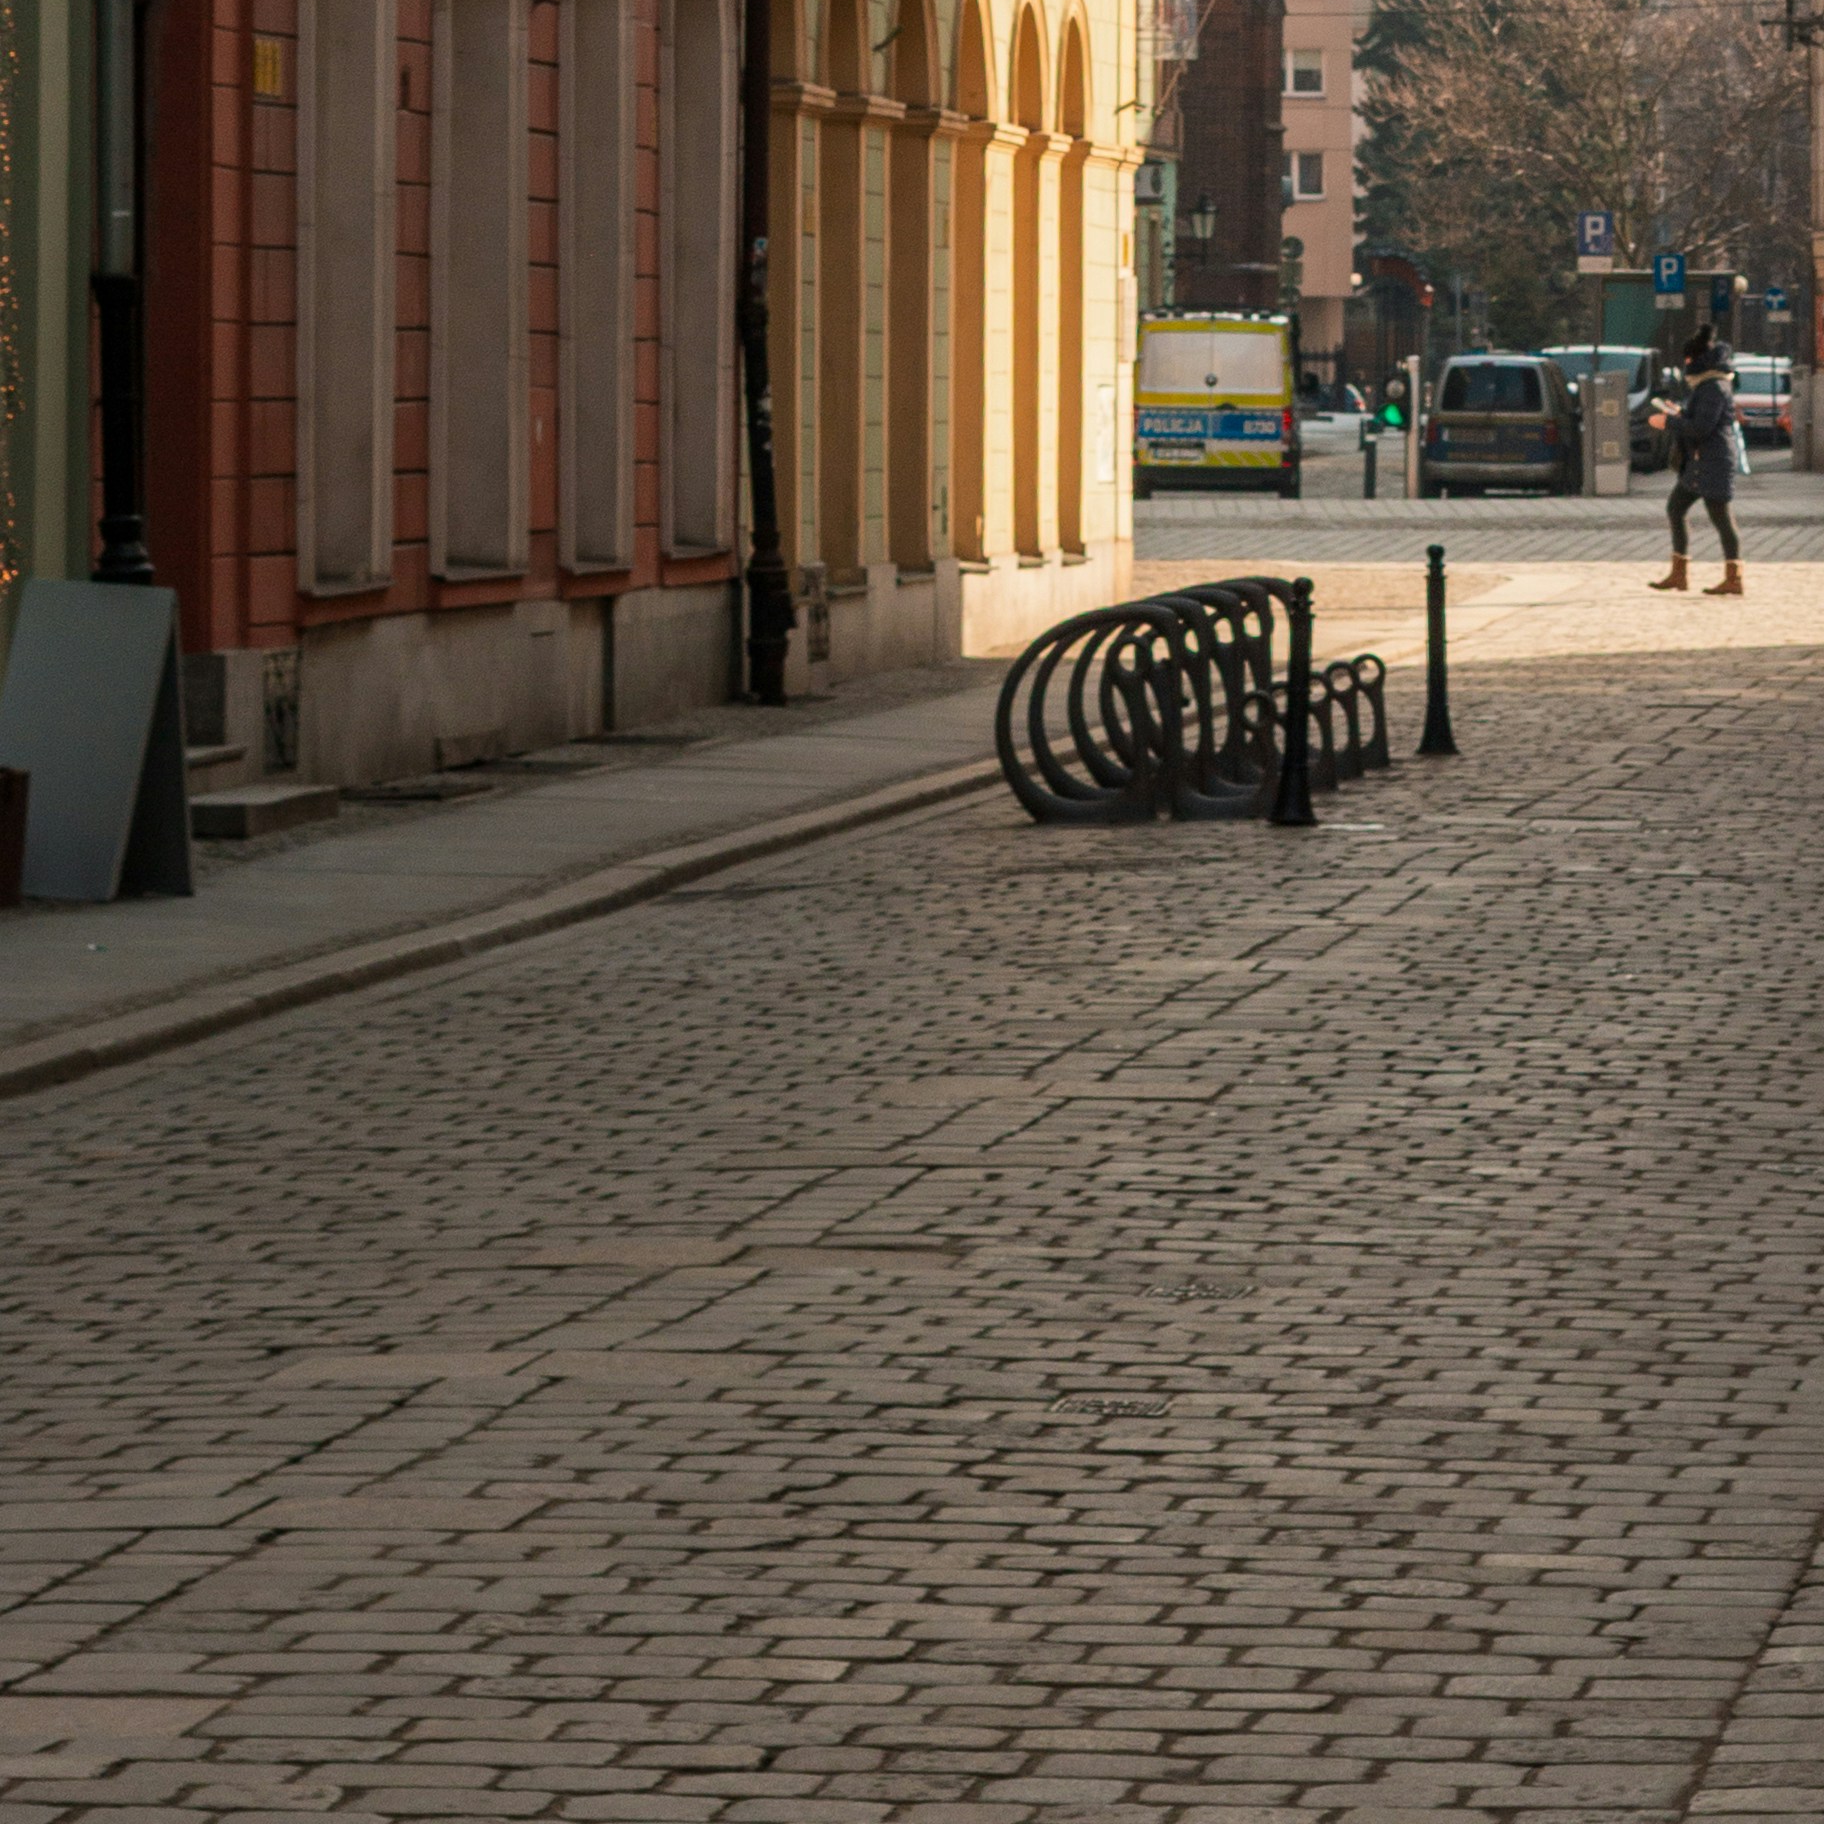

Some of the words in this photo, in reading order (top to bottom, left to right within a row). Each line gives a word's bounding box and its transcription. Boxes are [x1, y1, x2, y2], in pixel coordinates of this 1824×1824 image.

[1584, 215, 1605, 244] P
[1660, 257, 1678, 287] P
[1143, 417, 1203, 434] POLICJA
